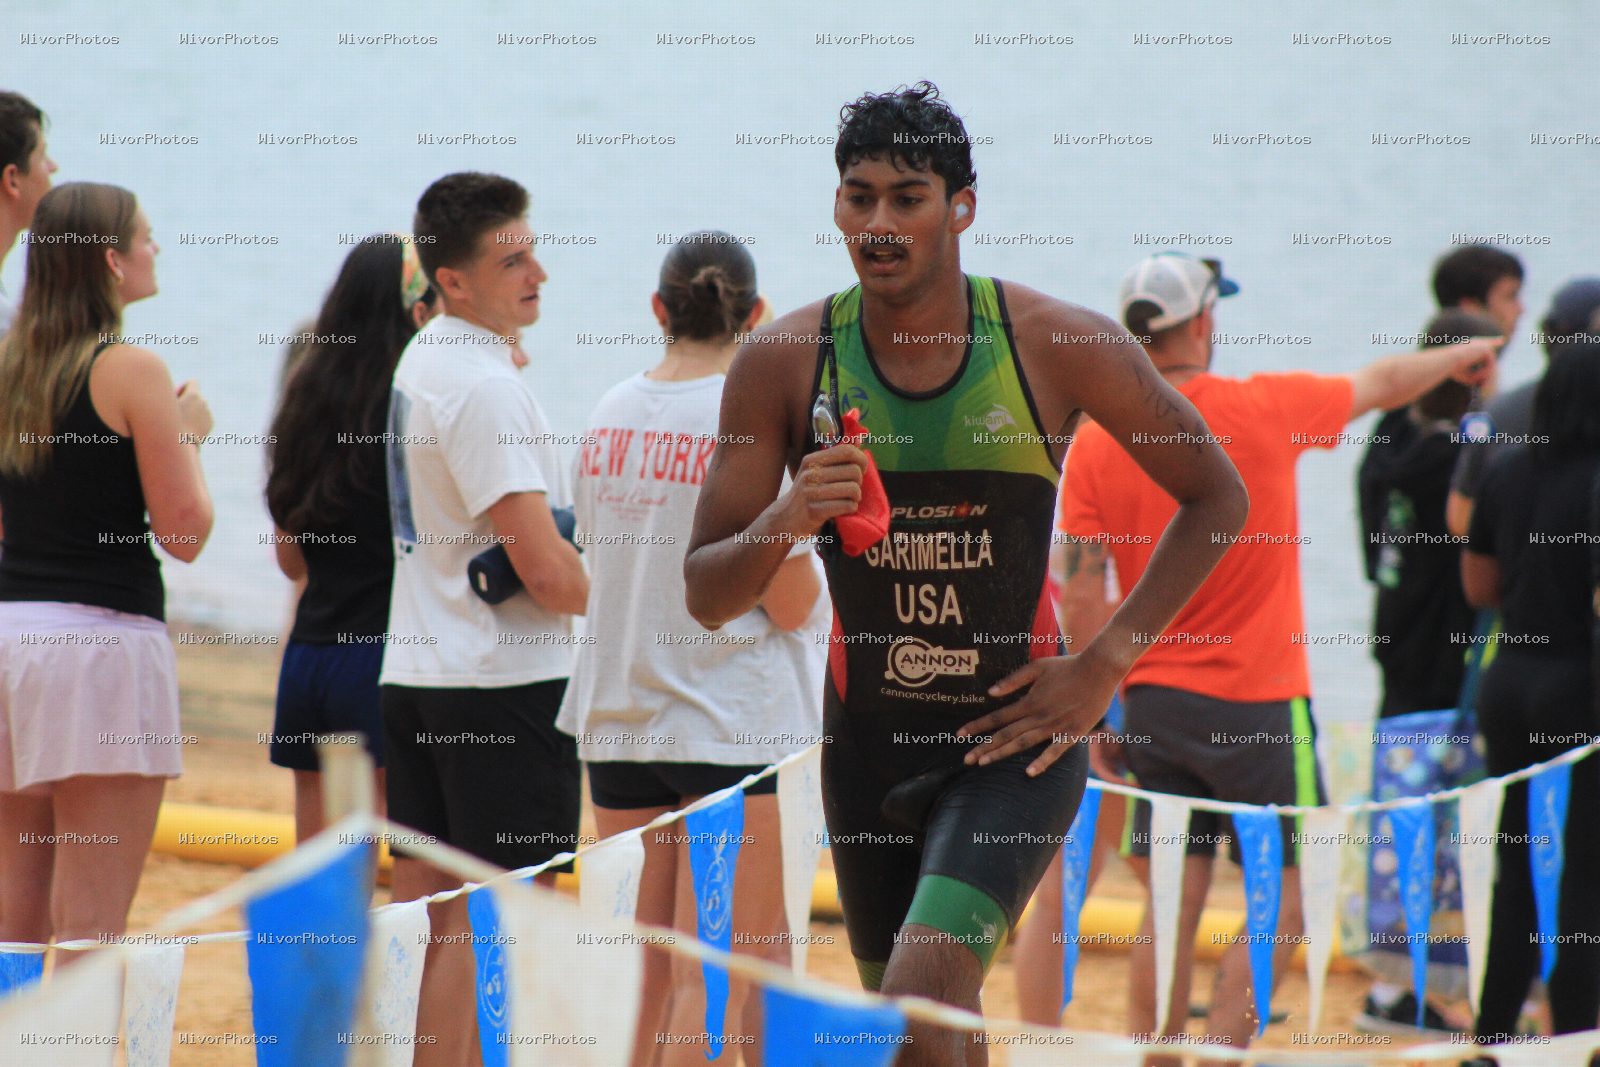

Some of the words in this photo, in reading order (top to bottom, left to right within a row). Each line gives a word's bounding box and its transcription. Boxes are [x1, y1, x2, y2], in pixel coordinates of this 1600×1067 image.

[579, 428, 634, 478] NEW
[639, 431, 717, 486] YORK
[864, 529, 994, 571] GARIMELLA
[894, 583, 963, 625] USA
[880, 687, 986, 705] cannoncyclery.bike
